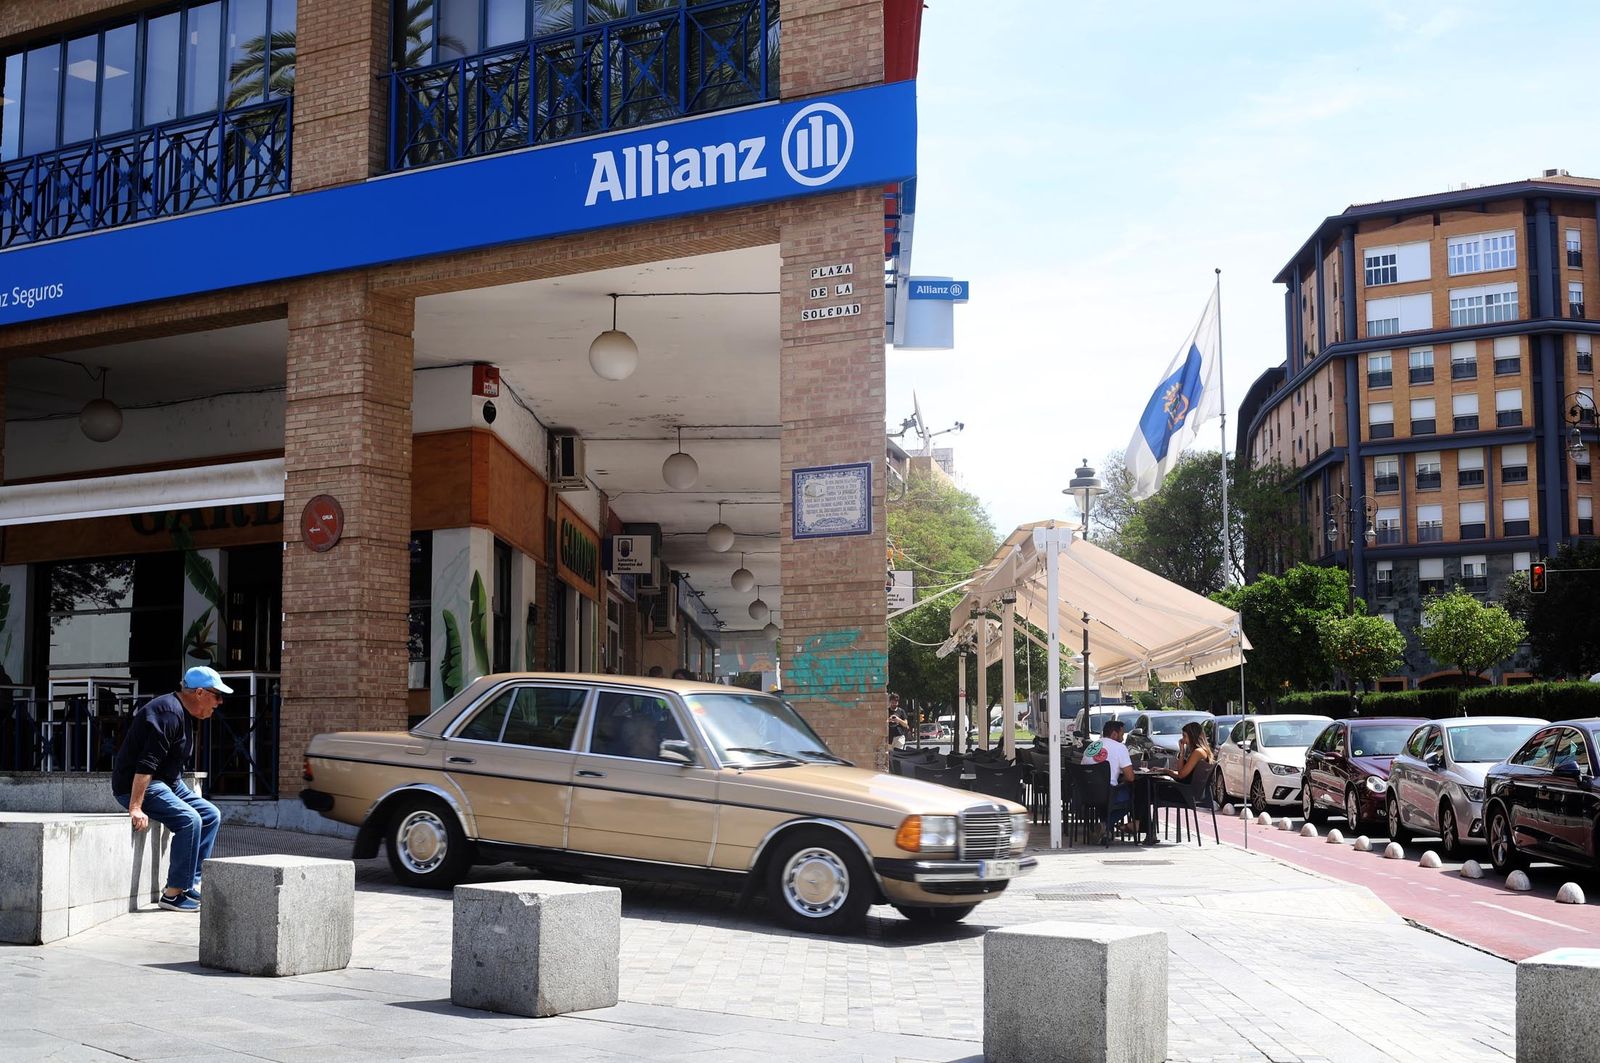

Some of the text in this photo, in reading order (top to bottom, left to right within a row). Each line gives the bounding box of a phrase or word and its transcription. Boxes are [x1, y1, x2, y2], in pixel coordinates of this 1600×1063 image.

[584, 136, 767, 207] Allianz
[811, 265, 851, 278] PLAZA
[12, 283, 64, 308] Seguros
[811, 284, 851, 298] DE LA
[916, 285, 949, 294] Allianz
[802, 305, 860, 320] SOLEDAD
